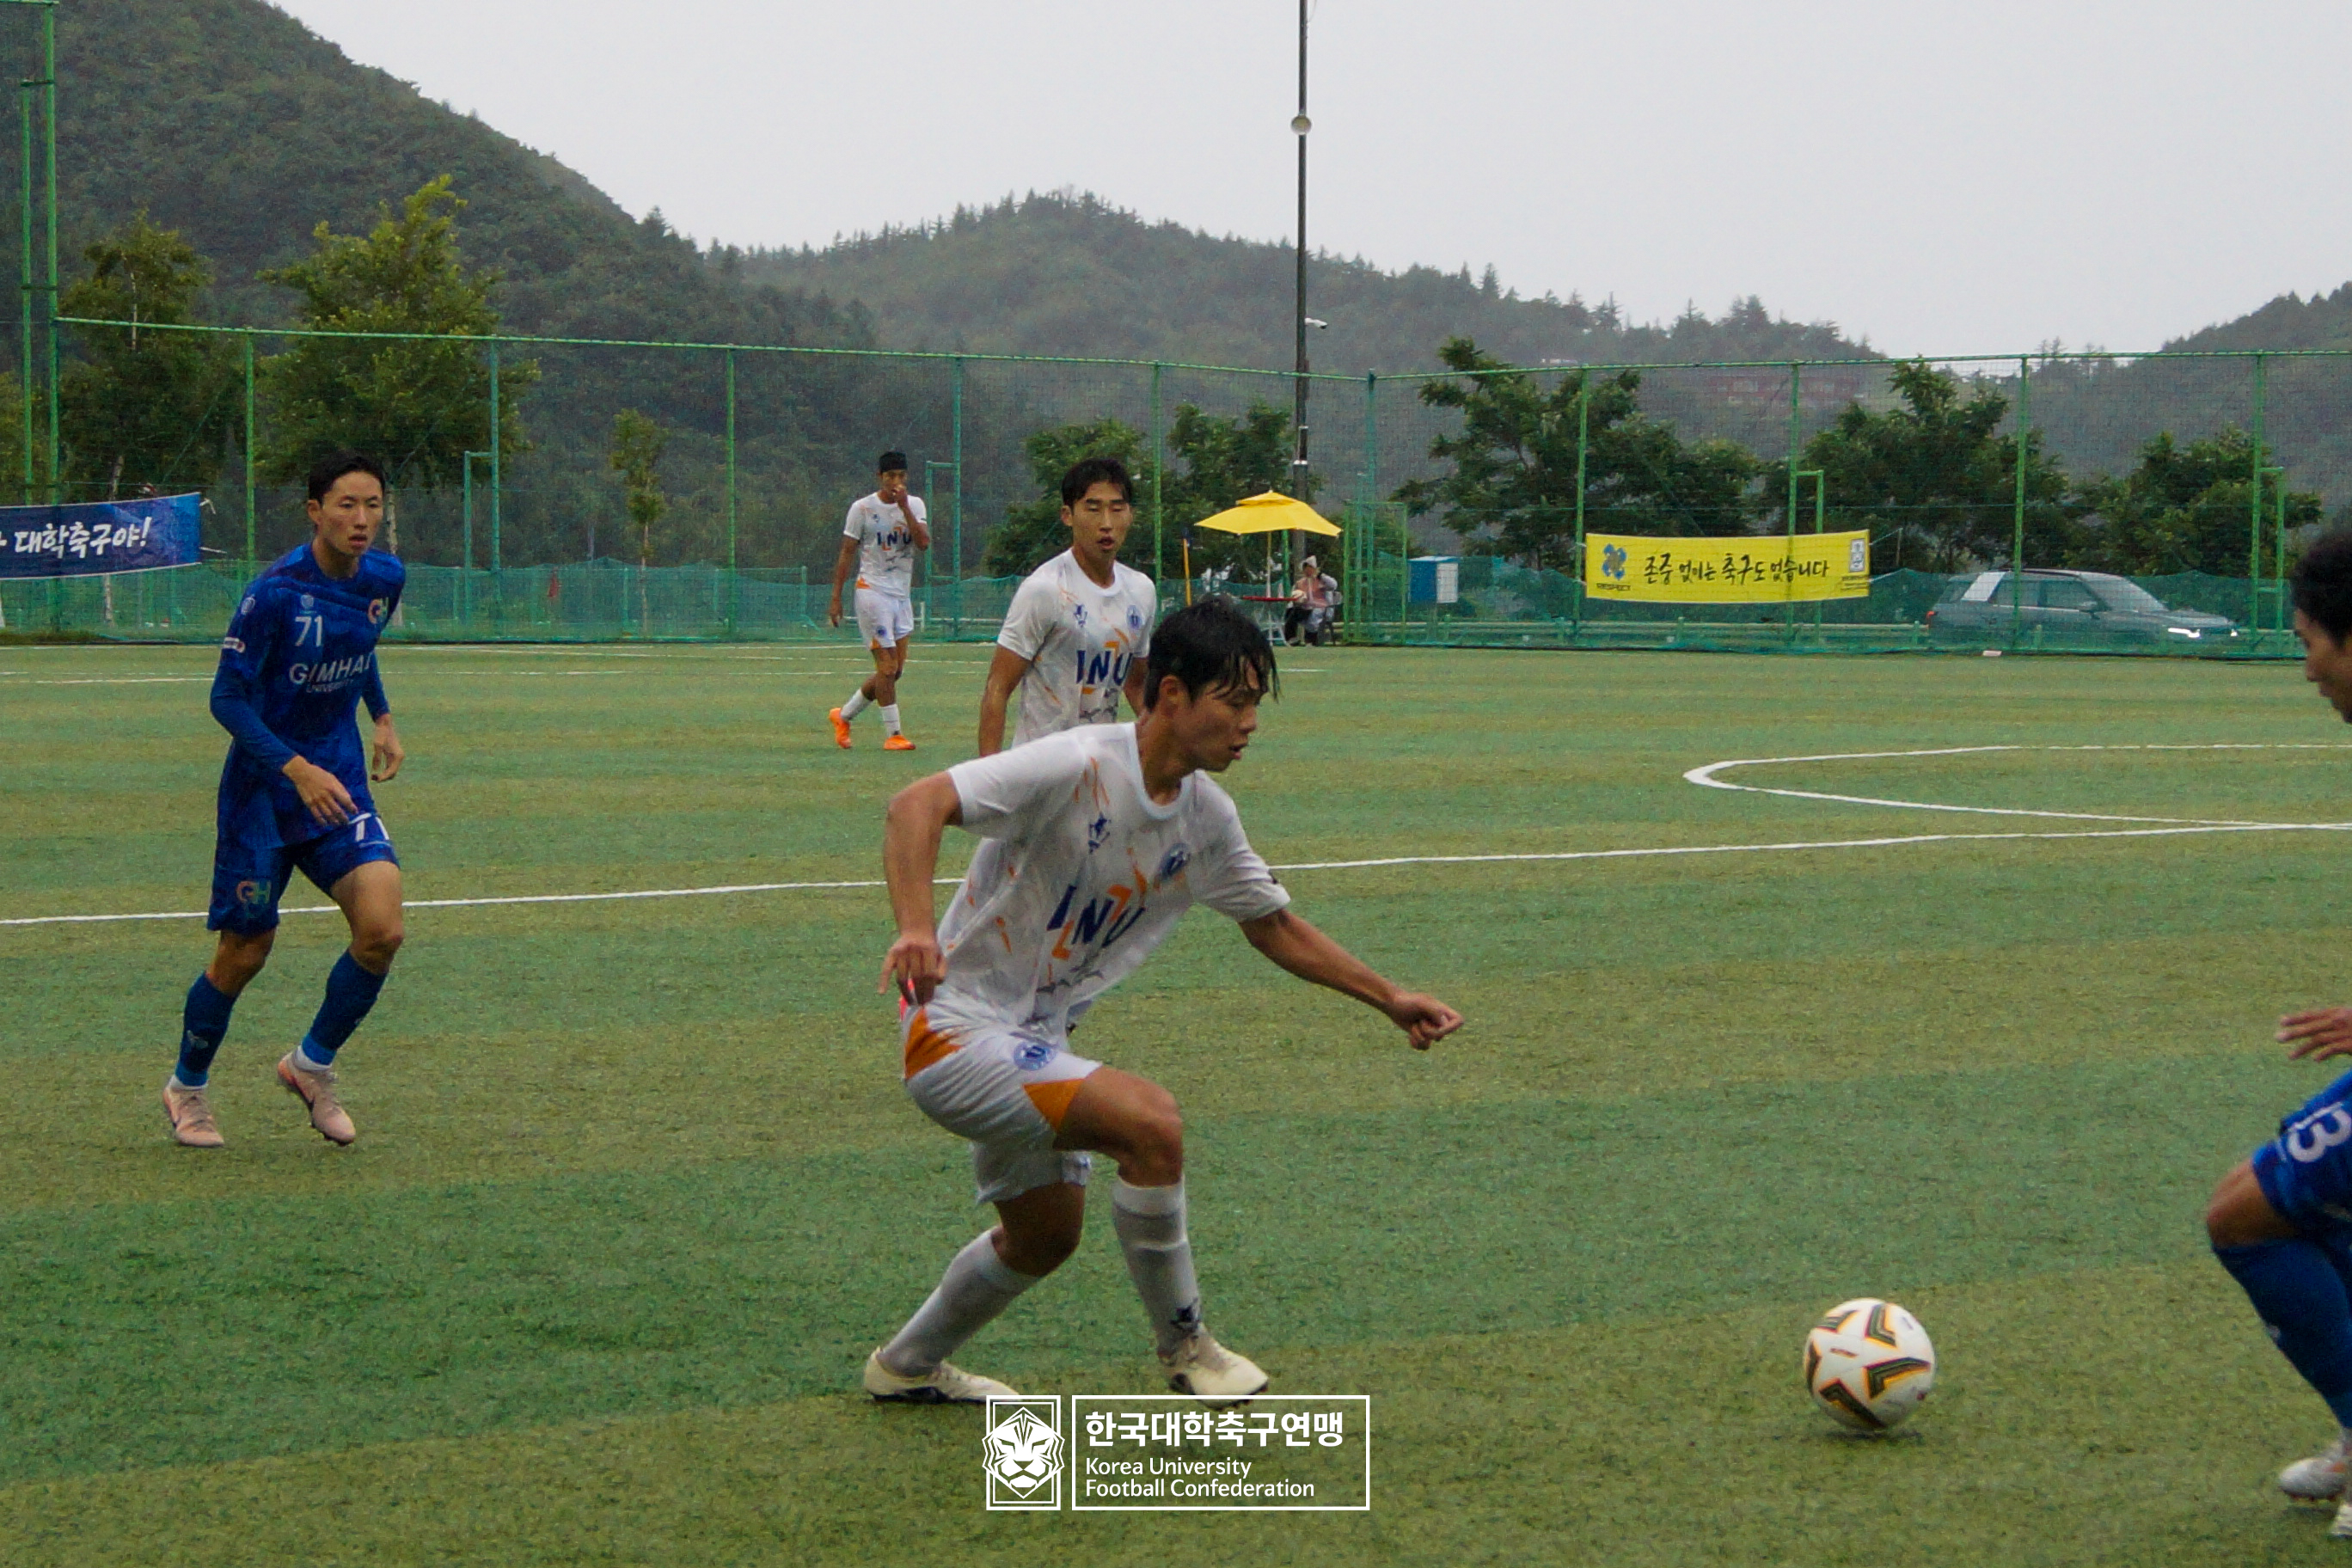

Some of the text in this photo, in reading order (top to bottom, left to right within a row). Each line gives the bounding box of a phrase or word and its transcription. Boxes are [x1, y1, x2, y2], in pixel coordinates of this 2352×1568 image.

[15, 516, 153, 560] 대학축구야!
[1644, 553, 1674, 585] 존중
[1679, 560, 1717, 584] 없이는
[1721, 553, 1766, 586] 축구도
[1770, 554, 1830, 584] 없습니다
[295, 615, 323, 647] 71
[1075, 649, 1134, 686] INU
[1046, 884, 1146, 949] INU
